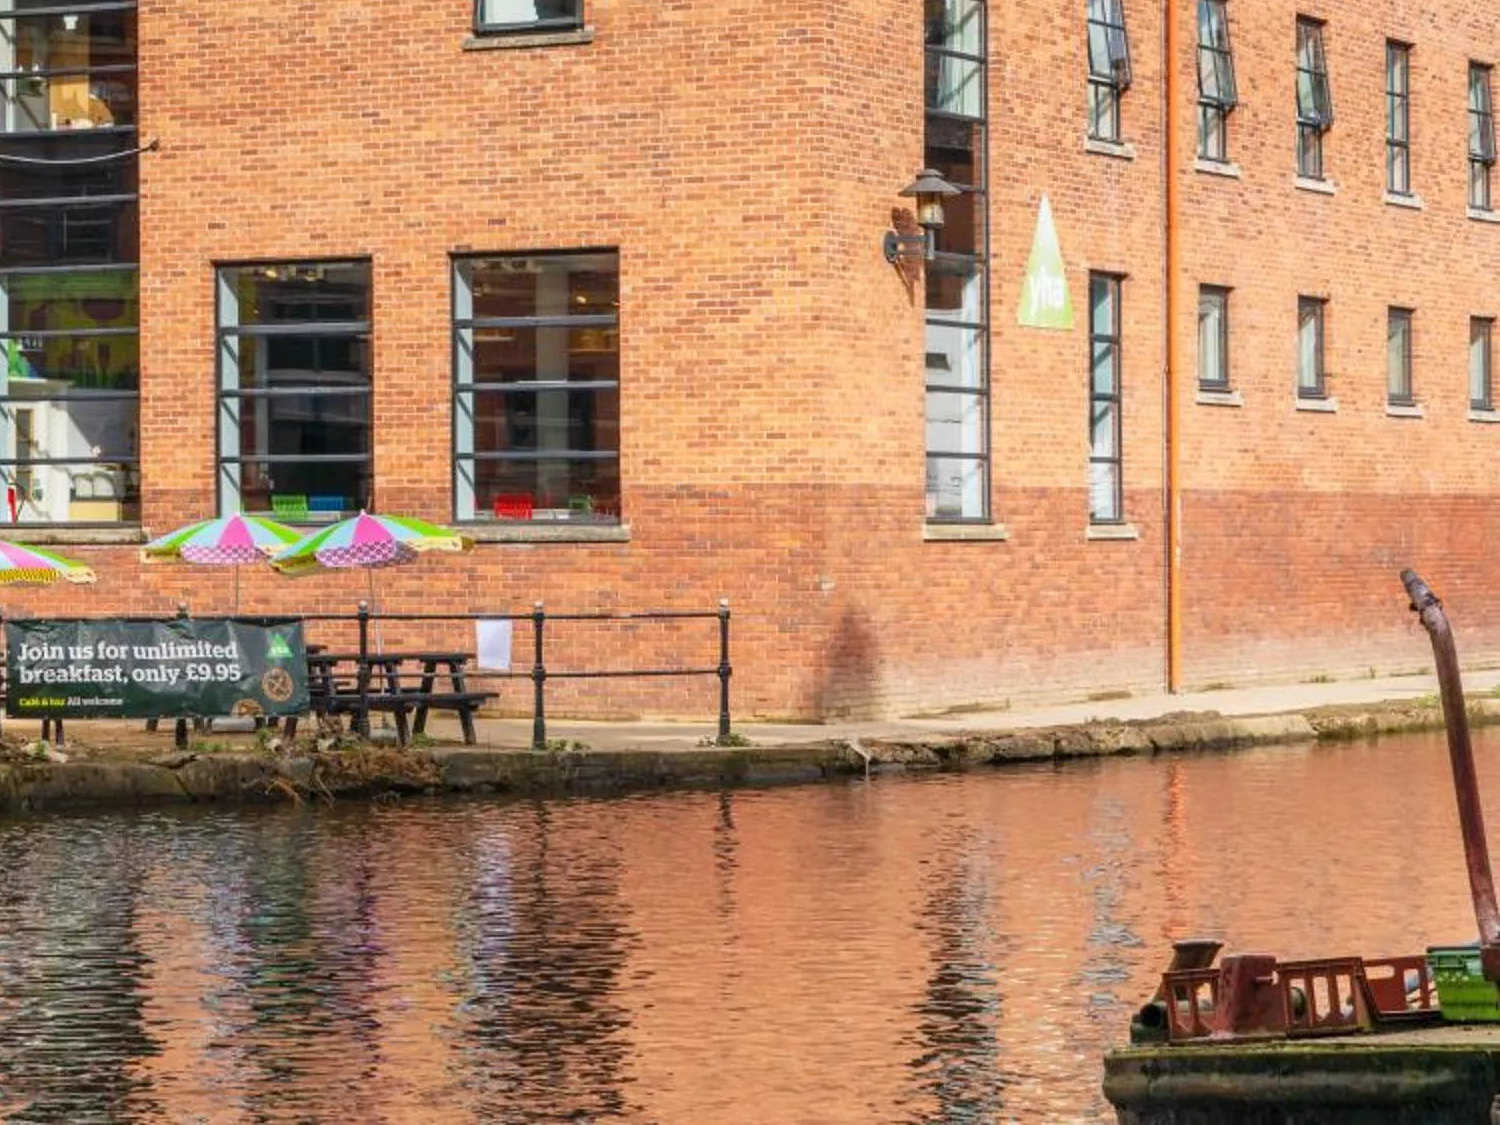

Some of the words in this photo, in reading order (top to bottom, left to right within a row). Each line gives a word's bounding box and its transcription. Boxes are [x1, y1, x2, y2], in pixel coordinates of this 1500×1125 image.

[17, 642, 65, 661] Join
[67, 644, 94, 660] us
[97, 640, 129, 660] for
[132, 640, 239, 660] unlimited
[19, 664, 129, 684] breakfast,
[131, 663, 181, 686] only
[186, 662, 242, 682] £9.95
